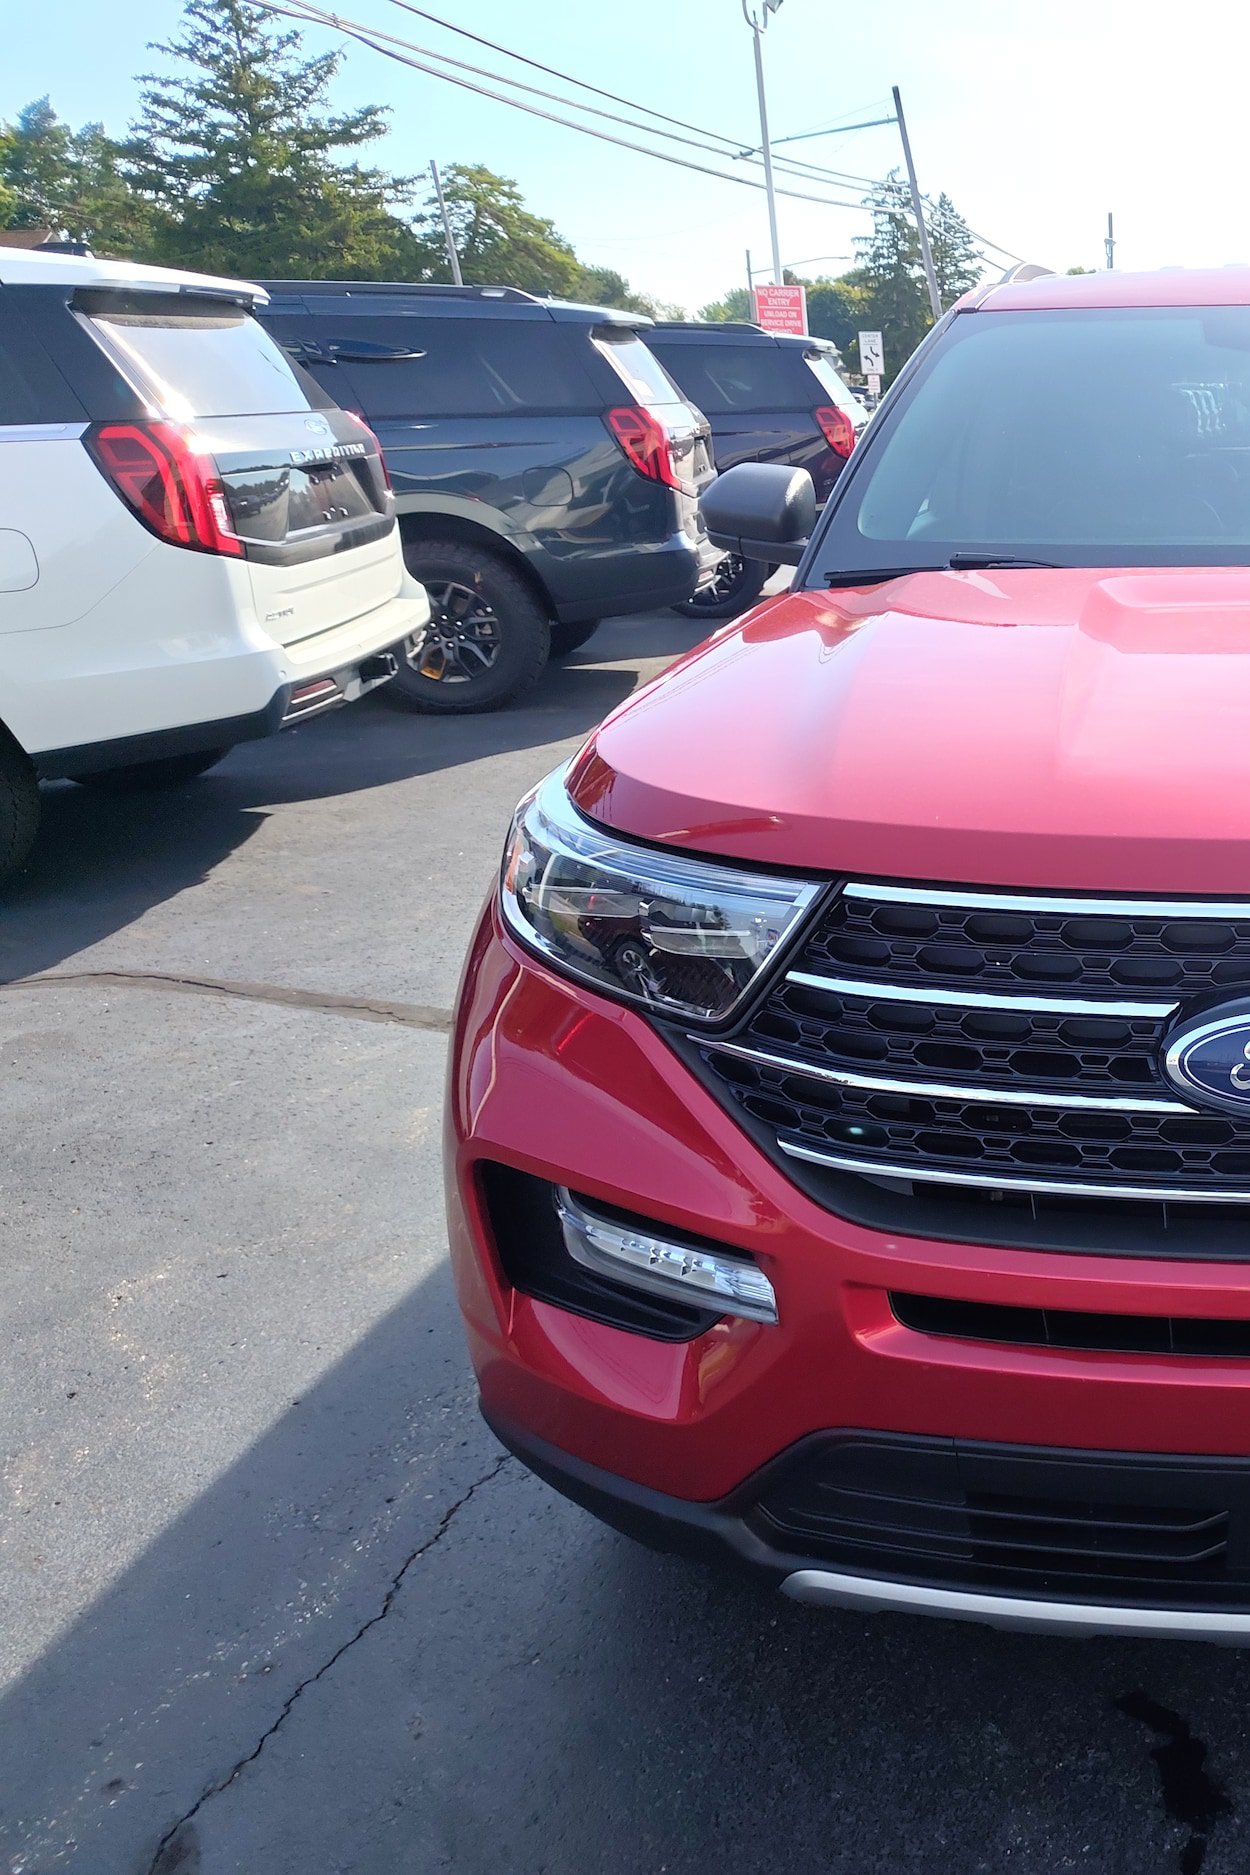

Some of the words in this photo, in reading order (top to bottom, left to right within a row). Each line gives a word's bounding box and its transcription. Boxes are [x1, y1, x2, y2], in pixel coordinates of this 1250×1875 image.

[758, 288, 768, 296] NO
[768, 288, 800, 298] CARRIER
[767, 297, 790, 306] ENTRY
[764, 310, 787, 318] UNLOAD
[760, 319, 785, 327] SERVICE
[785, 320, 802, 328] DRIVE
